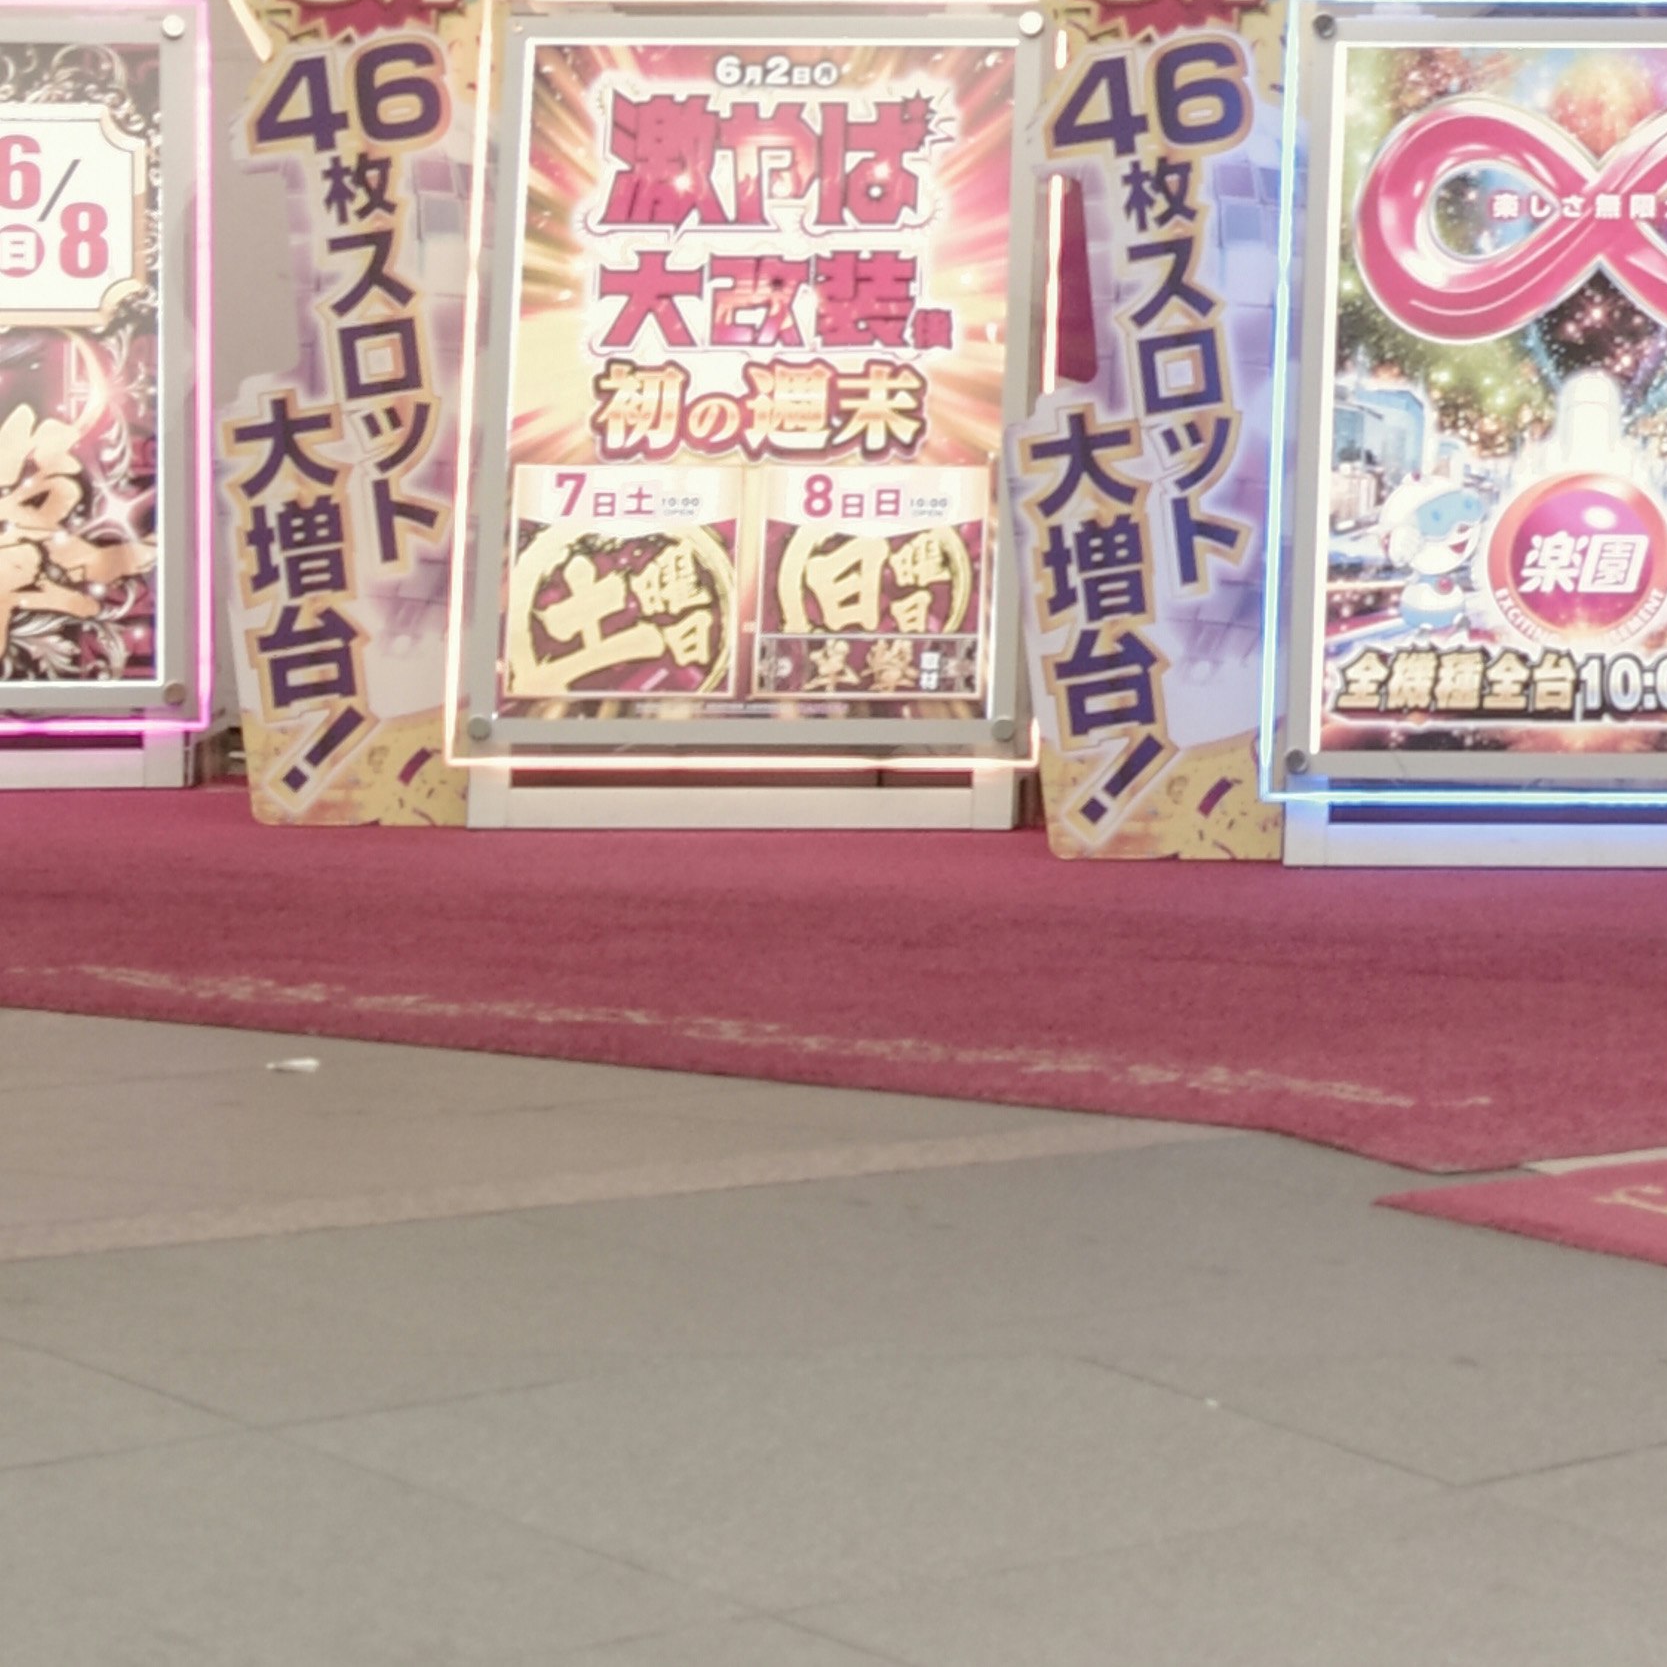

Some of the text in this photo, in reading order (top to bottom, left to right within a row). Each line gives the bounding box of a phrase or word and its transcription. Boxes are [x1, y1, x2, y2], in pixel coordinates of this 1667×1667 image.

[596, 362, 925, 452] 初の週末
[1518, 530, 1649, 594] 楽園
